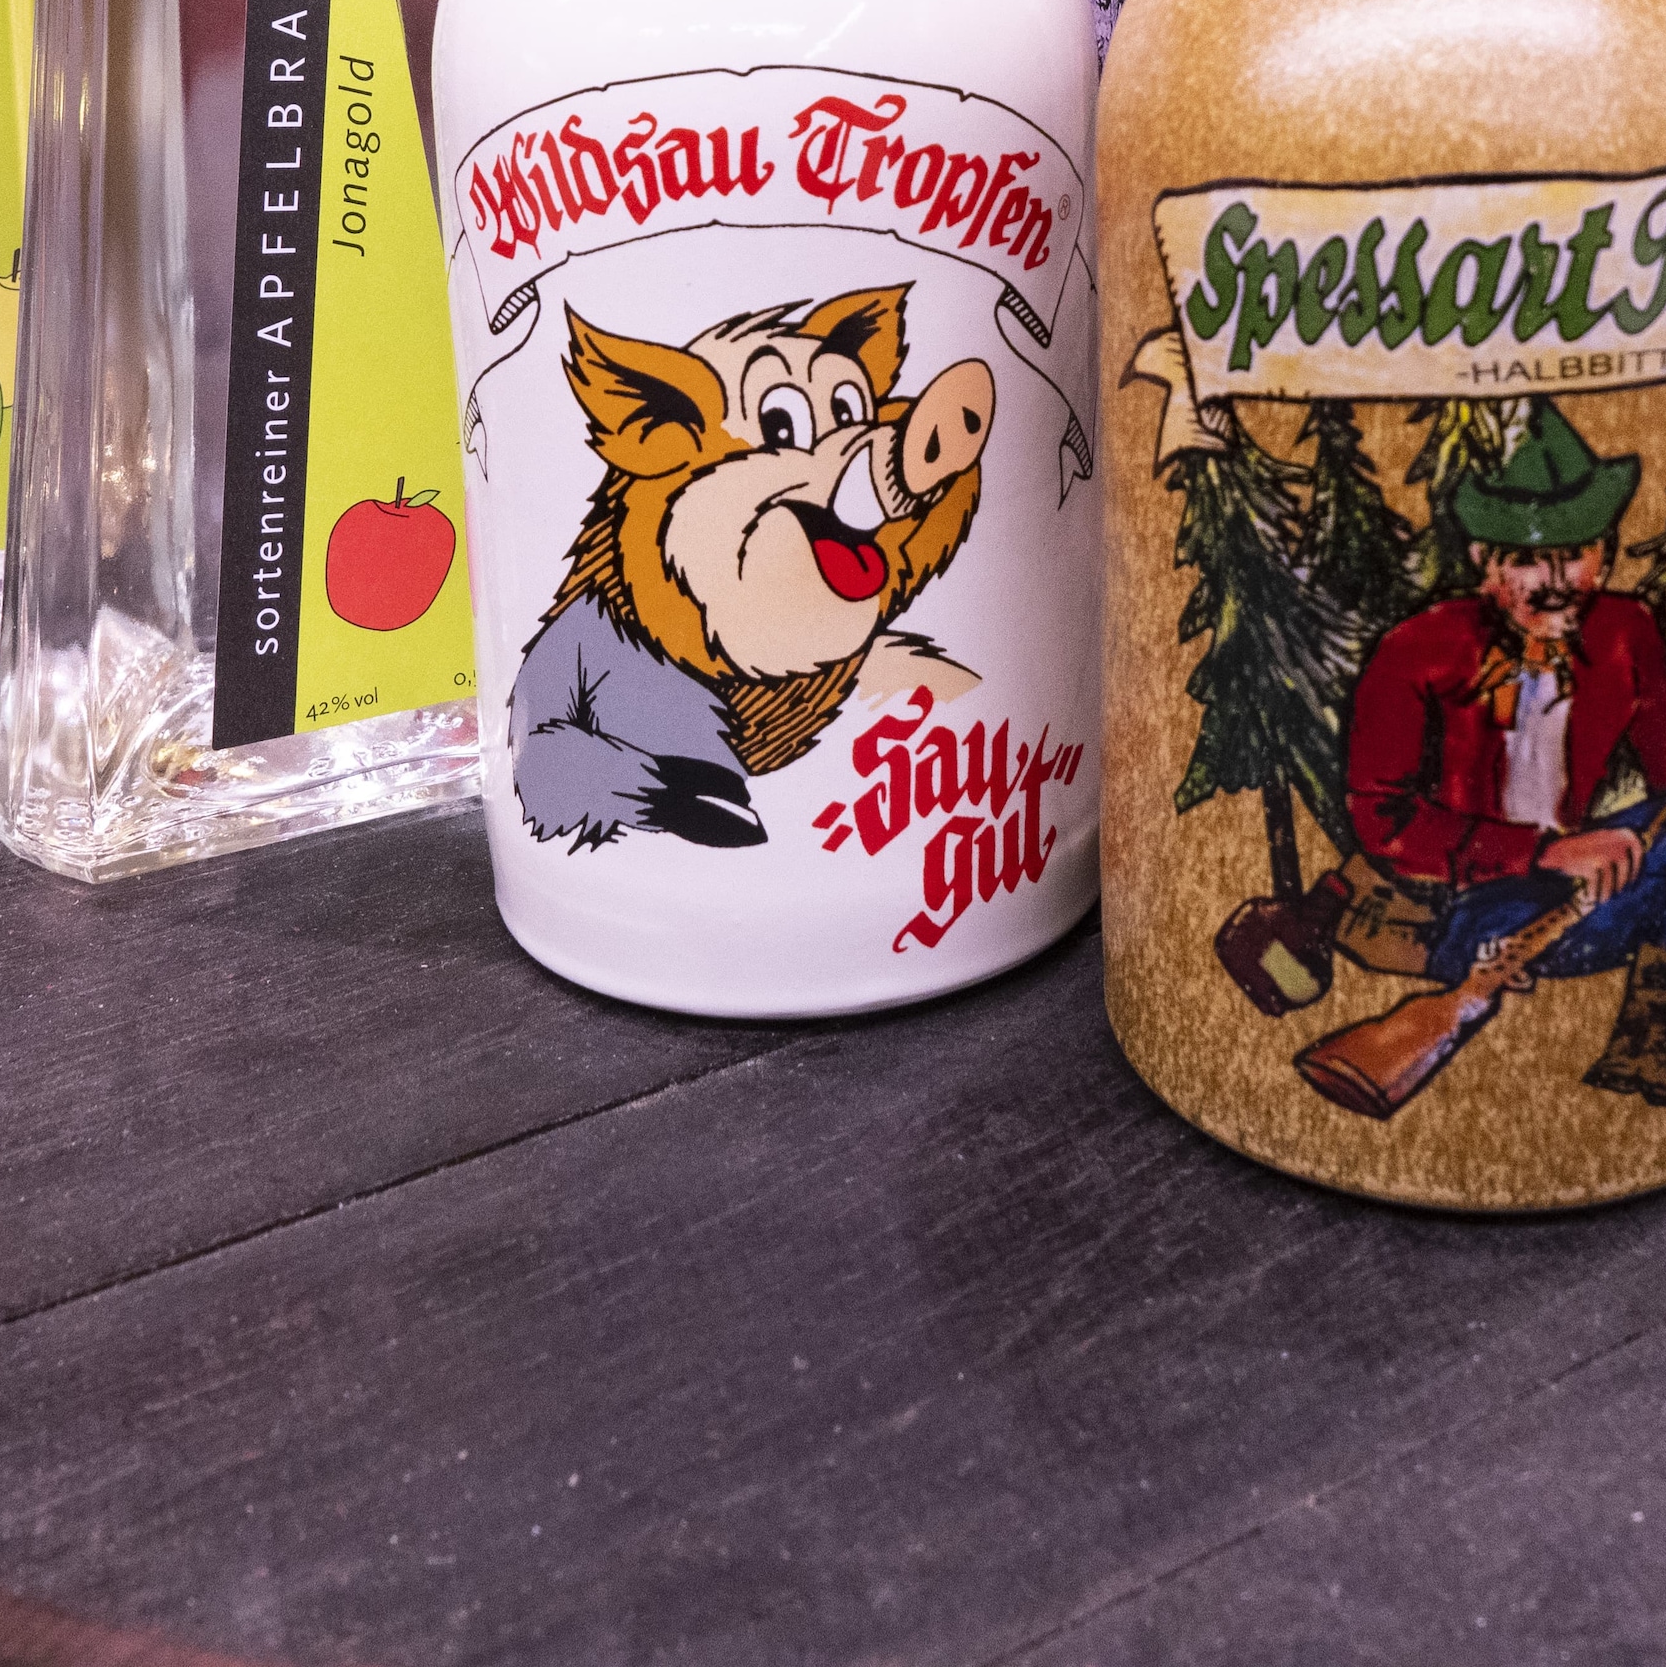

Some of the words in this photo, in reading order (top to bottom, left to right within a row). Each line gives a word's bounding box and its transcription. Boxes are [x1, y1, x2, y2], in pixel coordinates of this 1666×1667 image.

[332, 55, 381, 258] Jonagold
[468, 112, 775, 261] Wildsau
[788, 93, 1055, 272] Tropfen
[1186, 201, 1617, 373] Spessart
[253, 369, 293, 655] sortenreiner
[305, 693, 351, 722] 42%
[354, 686, 379, 708] vol
